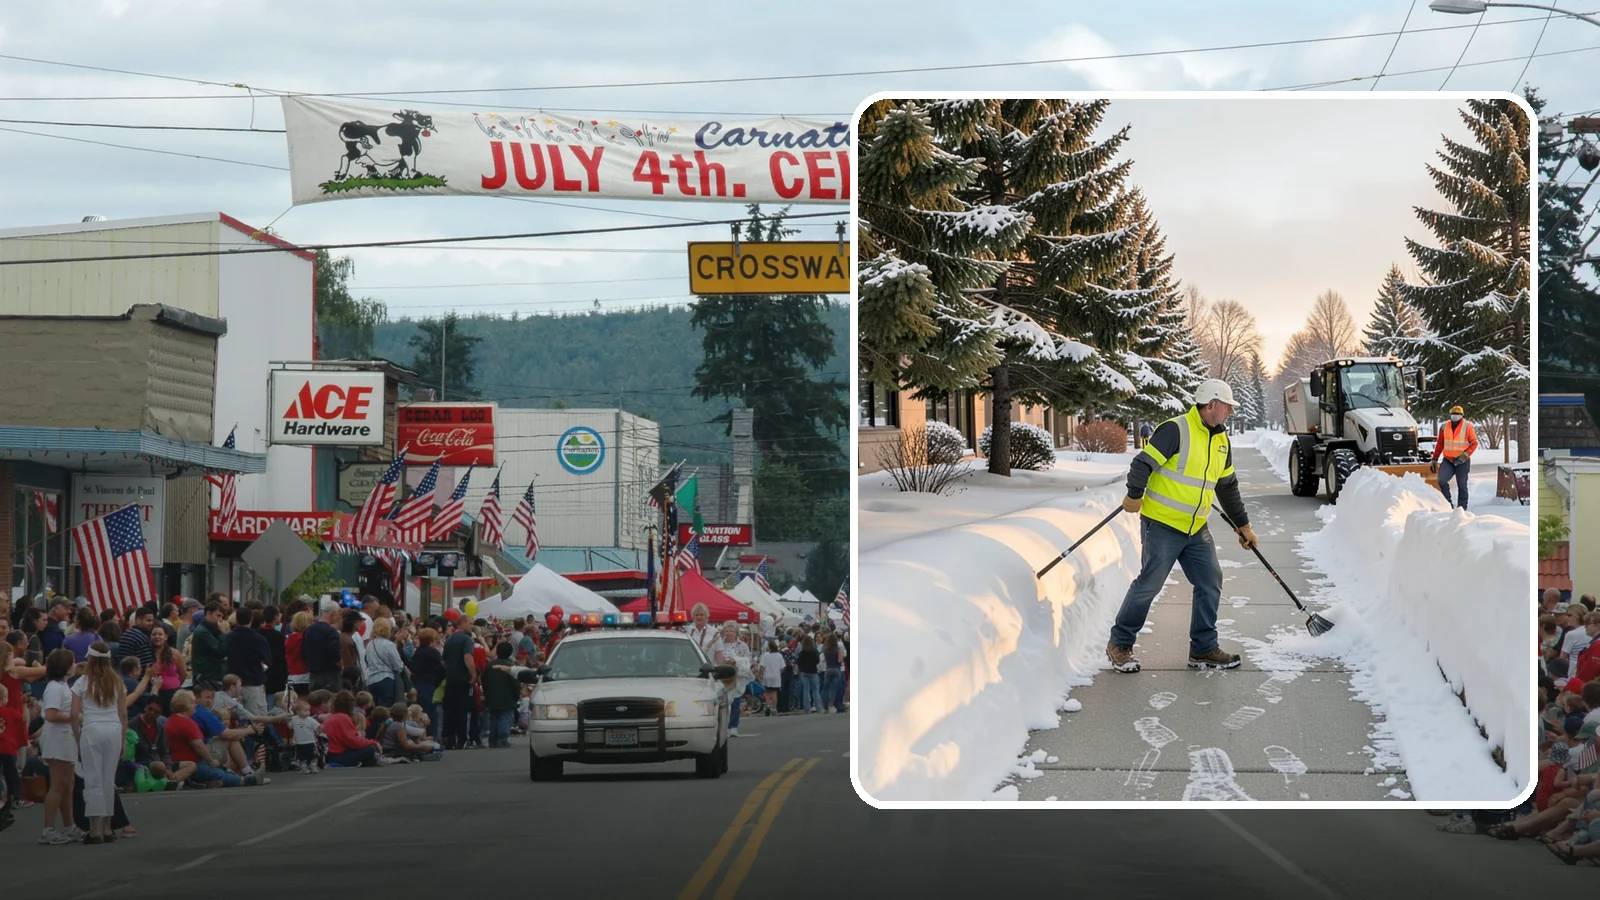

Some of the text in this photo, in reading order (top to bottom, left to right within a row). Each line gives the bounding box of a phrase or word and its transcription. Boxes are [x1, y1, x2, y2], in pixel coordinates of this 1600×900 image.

[481, 141, 605, 192] JULY
[633, 150, 746, 197] 4th.
[697, 254, 850, 280] CROSSWA
[283, 380, 373, 420] ACE
[405, 409, 452, 421] CEDAR
[284, 421, 370, 436] Hardware
[416, 428, 476, 447] Coca-Cola
[353, 467, 383, 480] Simpl
[95, 485, 123, 495] Vincent
[126, 486, 135, 495] de
[137, 486, 155, 495] Paul
[688, 526, 741, 535] CRNATION
[699, 535, 730, 543] GLASS
